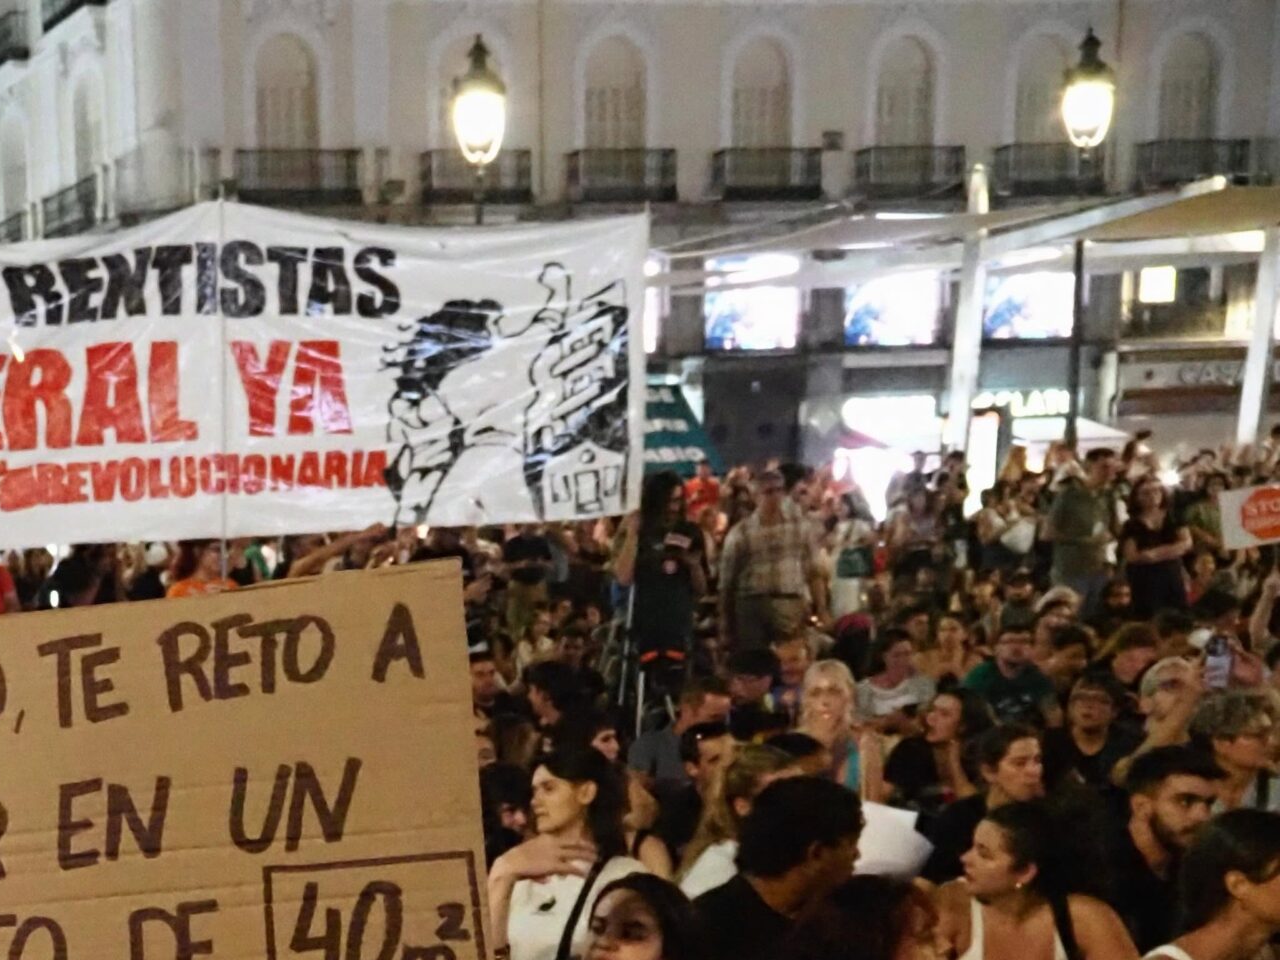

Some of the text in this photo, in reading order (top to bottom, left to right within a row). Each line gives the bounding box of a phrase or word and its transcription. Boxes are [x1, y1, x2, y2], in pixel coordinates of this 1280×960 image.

[2, 240, 402, 328] RENTISTAS
[231, 340, 353, 437] YA
[34, 450, 389, 504] REVOLUCIONARIA
[38, 632, 130, 729] TE
[157, 613, 337, 713] RETO
[372, 602, 425, 683] A
[57, 776, 172, 871] EN
[229, 757, 363, 854] UN
